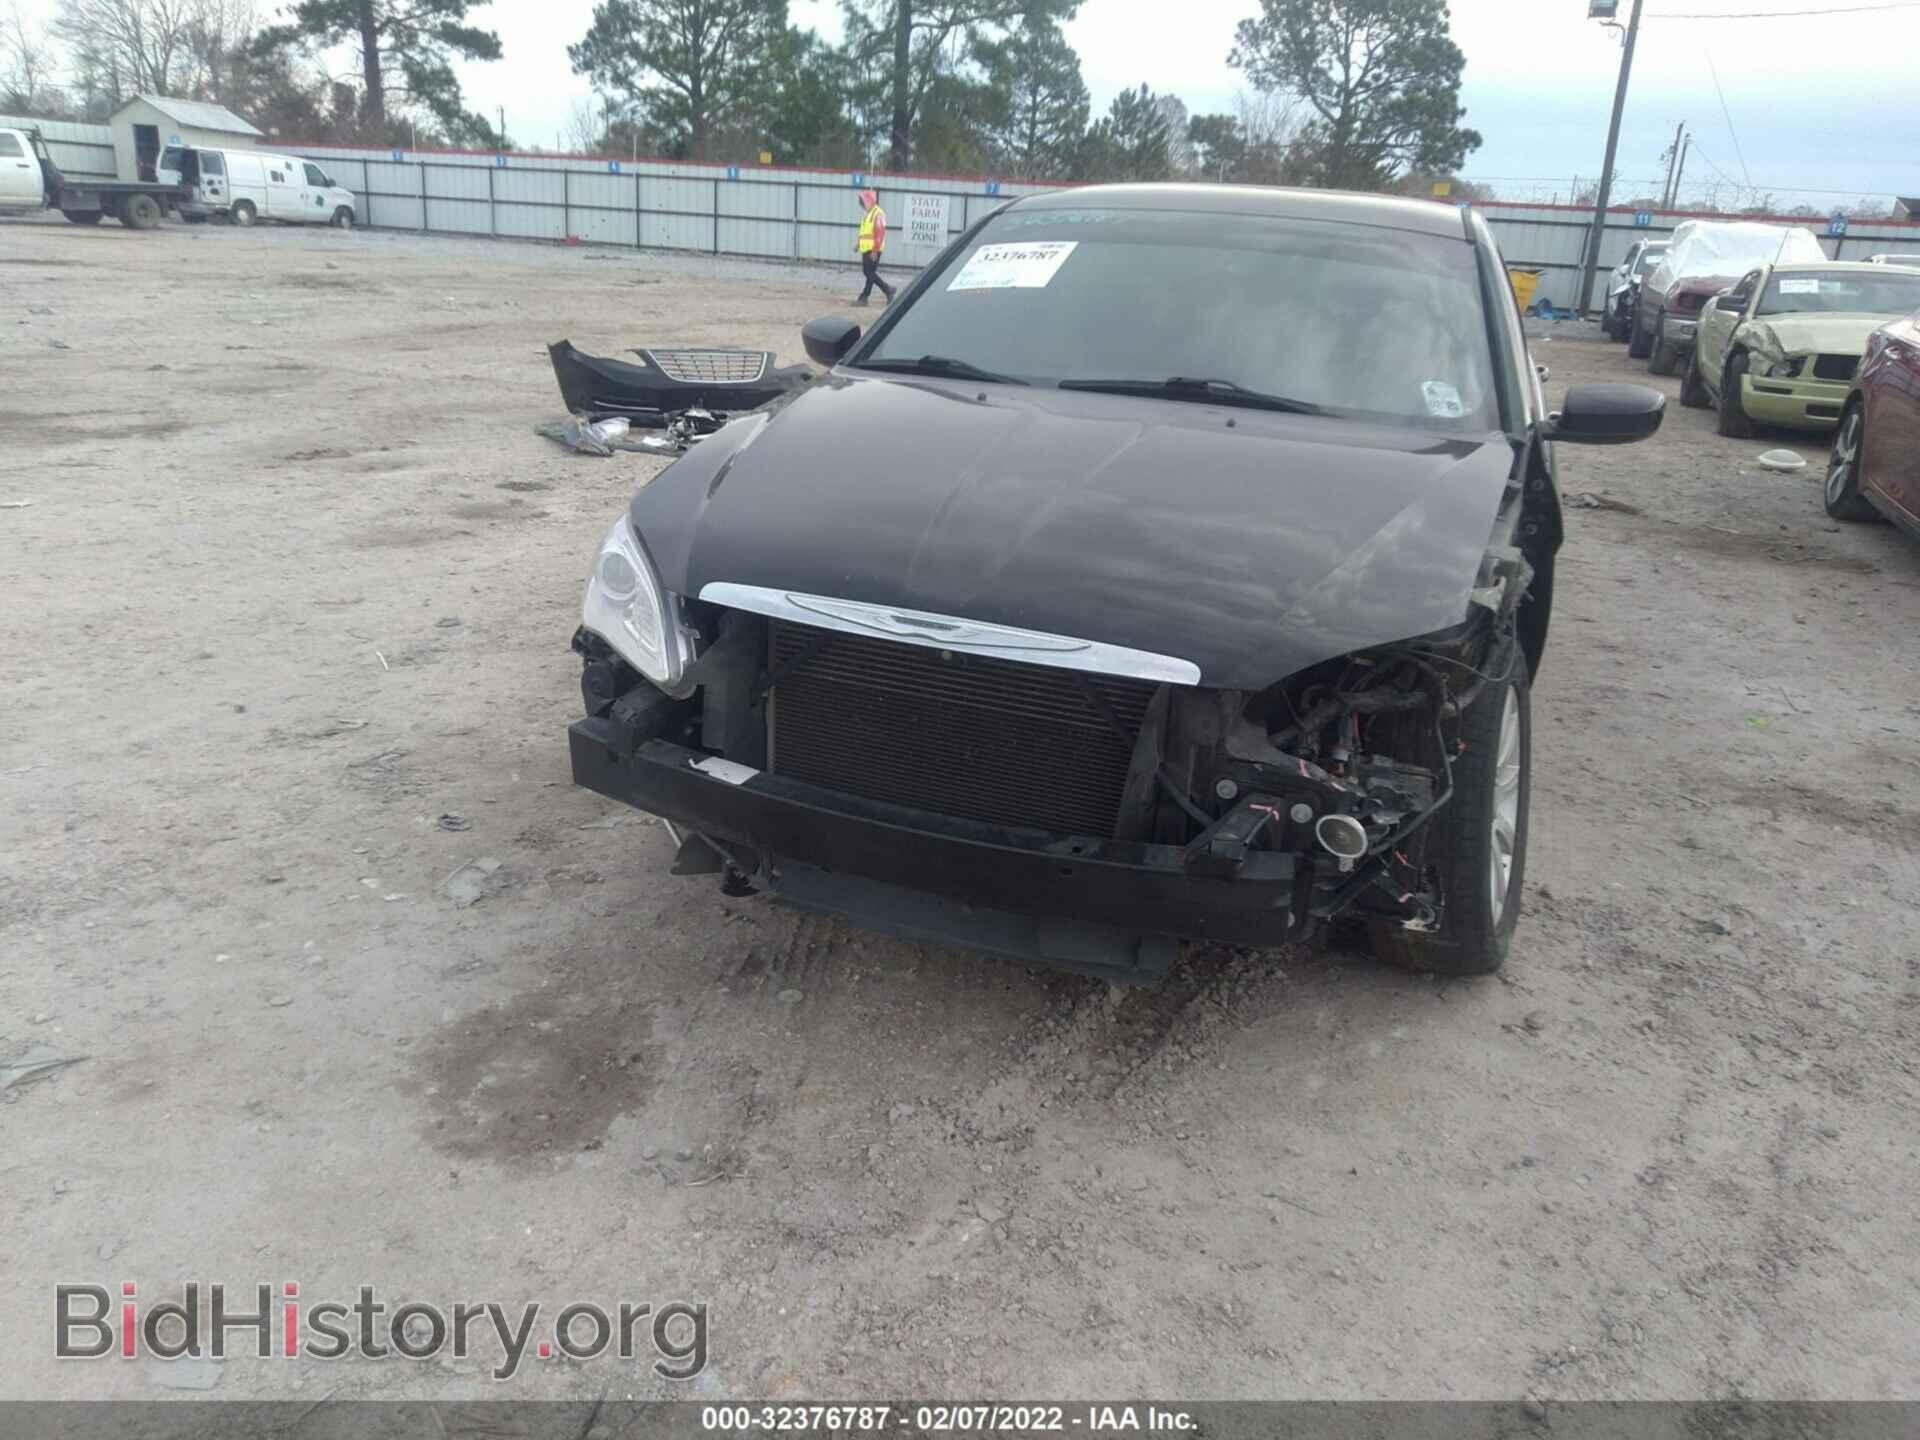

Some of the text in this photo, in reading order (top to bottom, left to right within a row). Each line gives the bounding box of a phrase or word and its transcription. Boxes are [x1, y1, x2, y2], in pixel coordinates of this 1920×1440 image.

[911, 197, 943, 207] STATE
[911, 208, 941, 219] FARM
[911, 221, 940, 231] DROP
[1831, 223, 1846, 234] 12
[911, 231, 936, 242] ZONE
